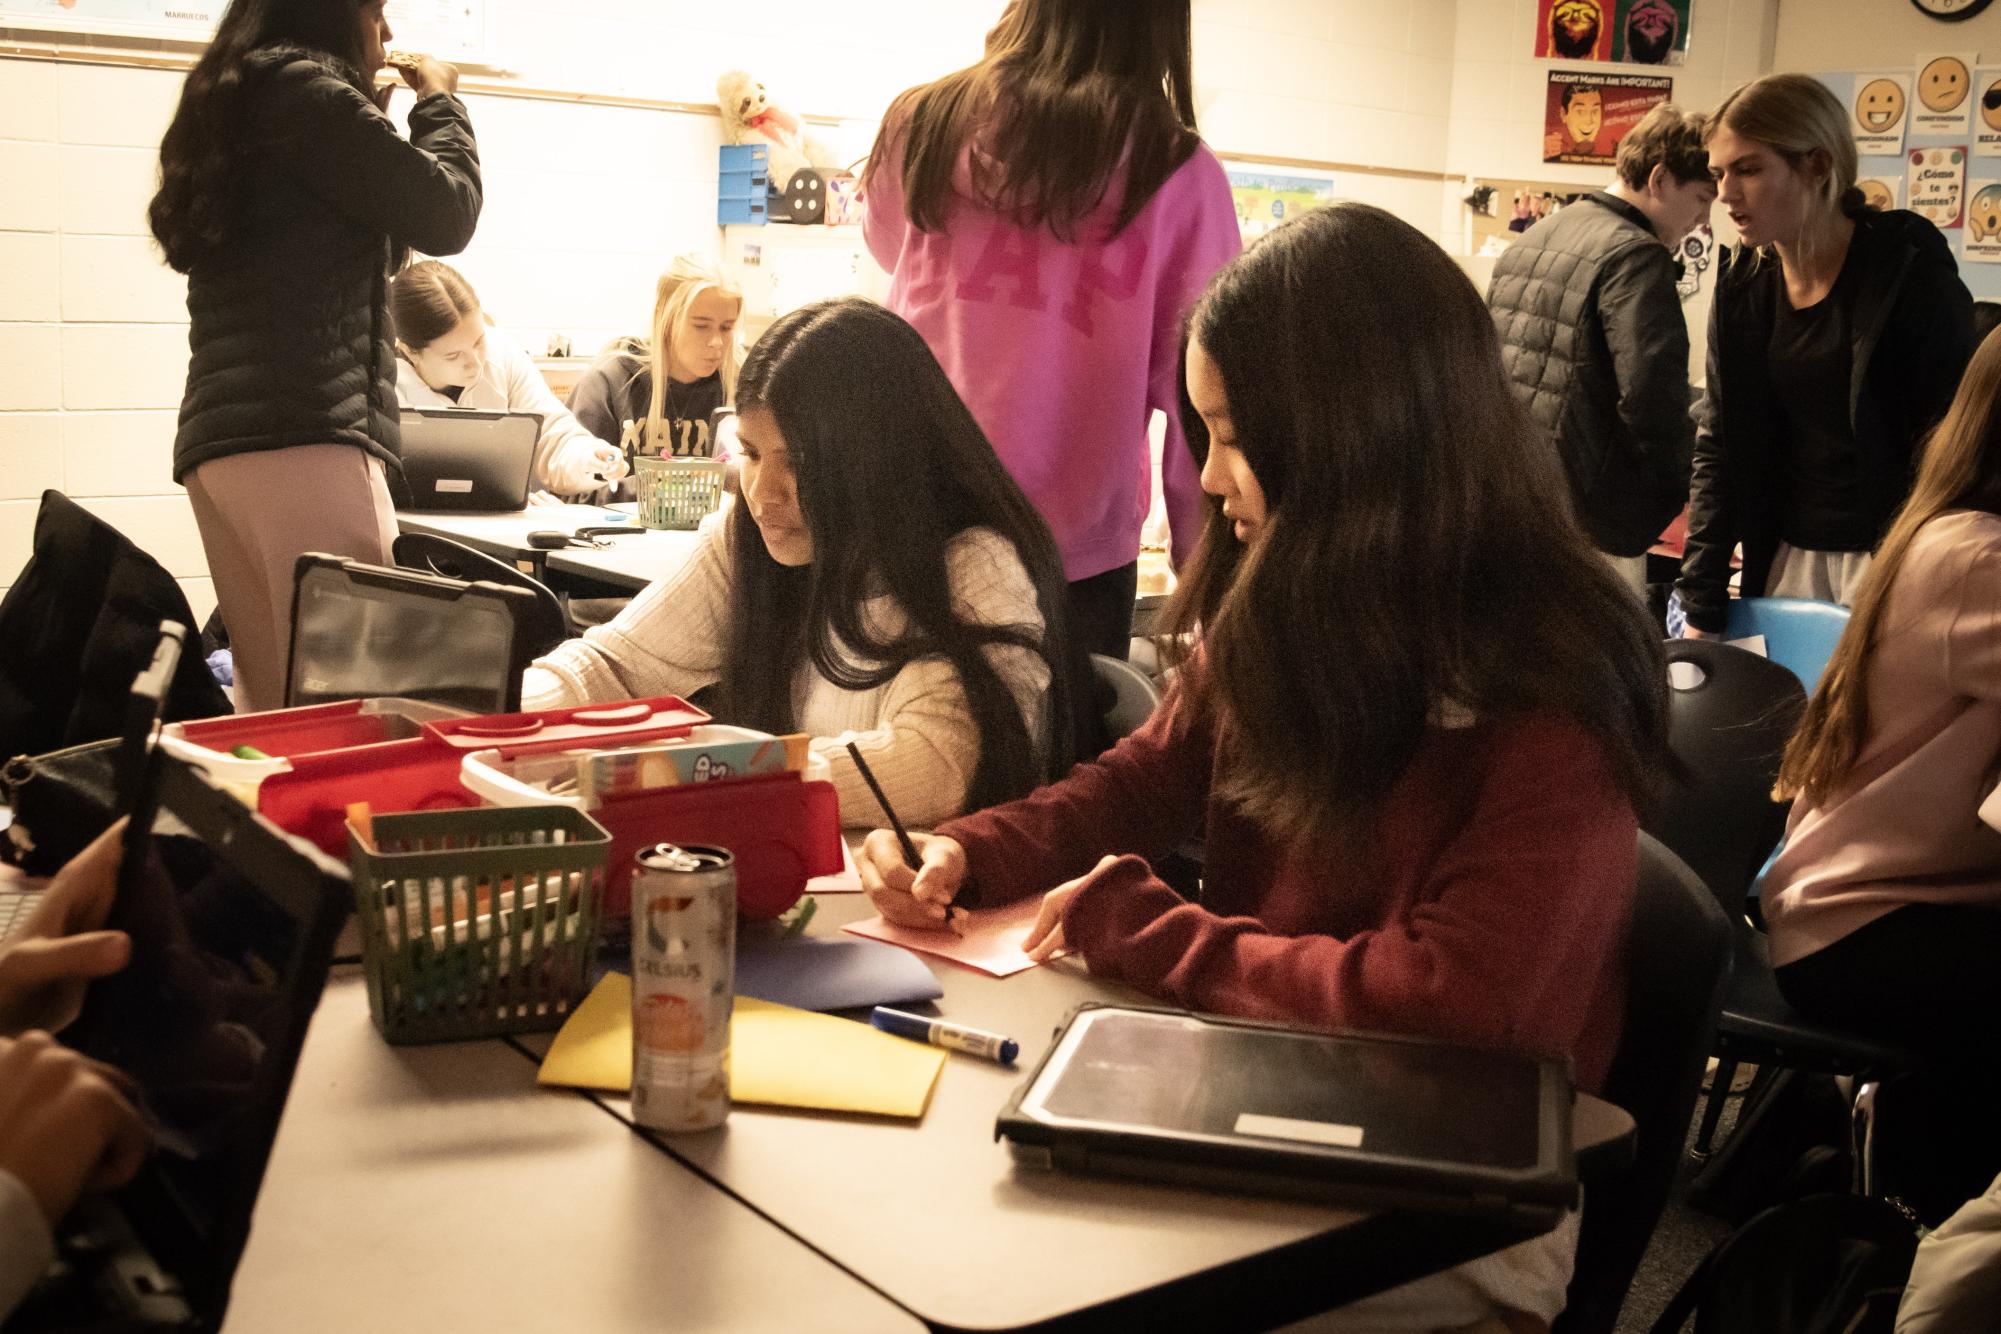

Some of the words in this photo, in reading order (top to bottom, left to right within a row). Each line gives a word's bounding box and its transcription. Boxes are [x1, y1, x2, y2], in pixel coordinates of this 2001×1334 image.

[165, 11, 209, 21] MARRUECOS
[1916, 169, 1955, 181] ¿Cómo
[1930, 184, 1940, 192] te
[1912, 197, 1956, 206] sientes?
